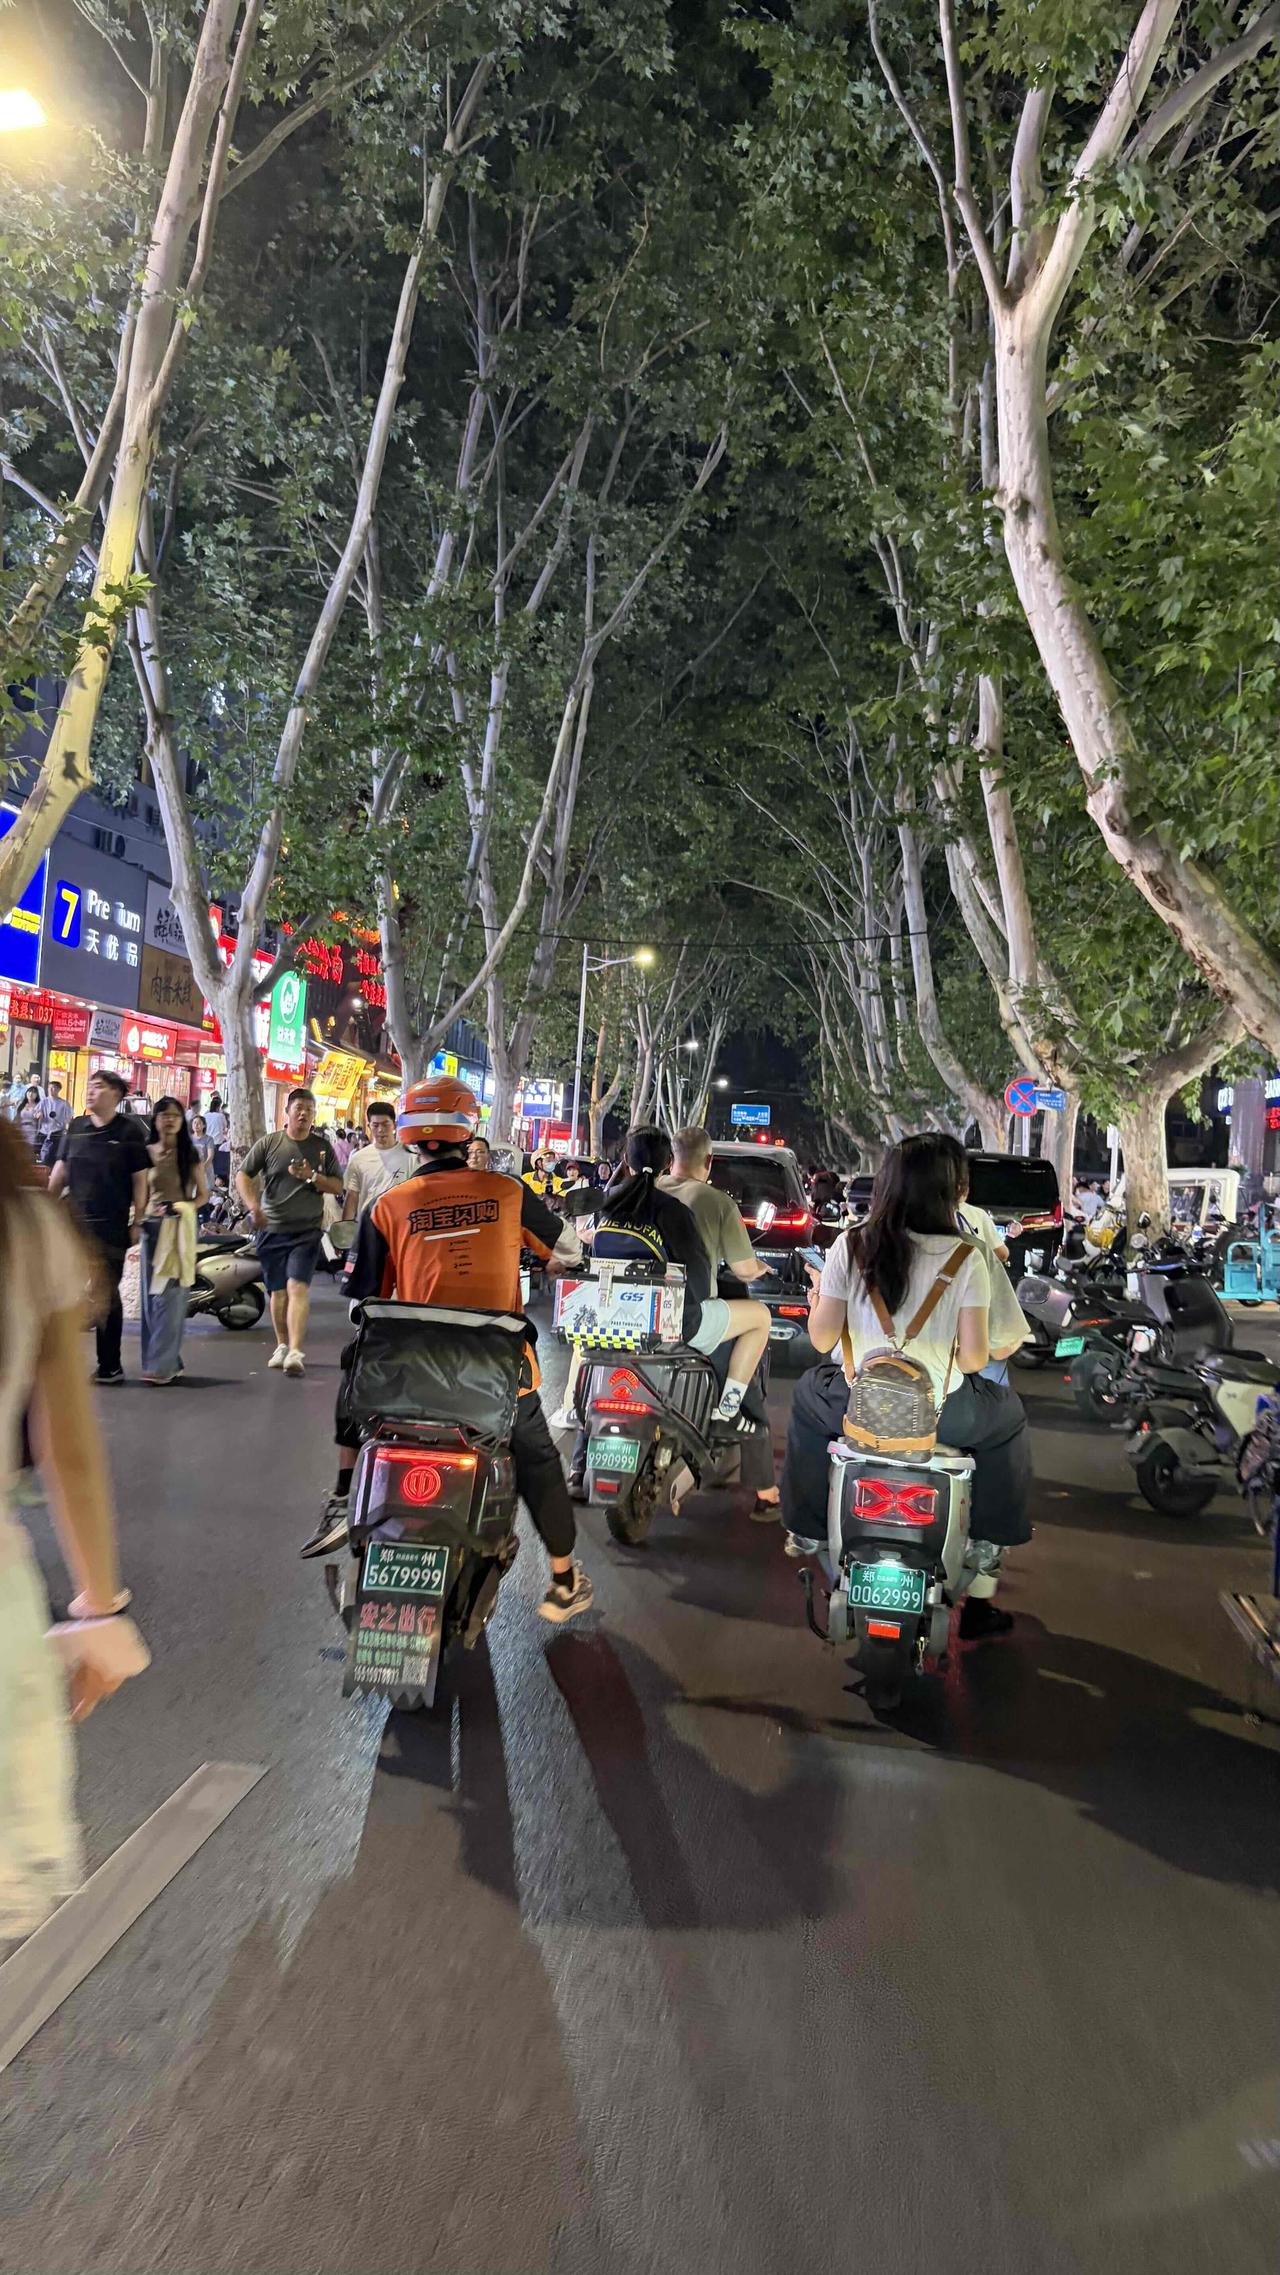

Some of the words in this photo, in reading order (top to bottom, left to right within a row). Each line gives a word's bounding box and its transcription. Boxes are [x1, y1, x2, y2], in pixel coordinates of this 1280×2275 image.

[61, 888, 79, 938] 7
[87, 889, 141, 933] Preium
[86, 928, 138, 967] 天优品
[408, 1199, 499, 1235] 淘宝闪购
[619, 1291, 645, 1302] GS
[589, 1452, 635, 1469] 9990999
[368, 1564, 442, 1590] 5679999
[900, 1575, 914, 1589] 州
[852, 1585, 921, 1609] 0062999
